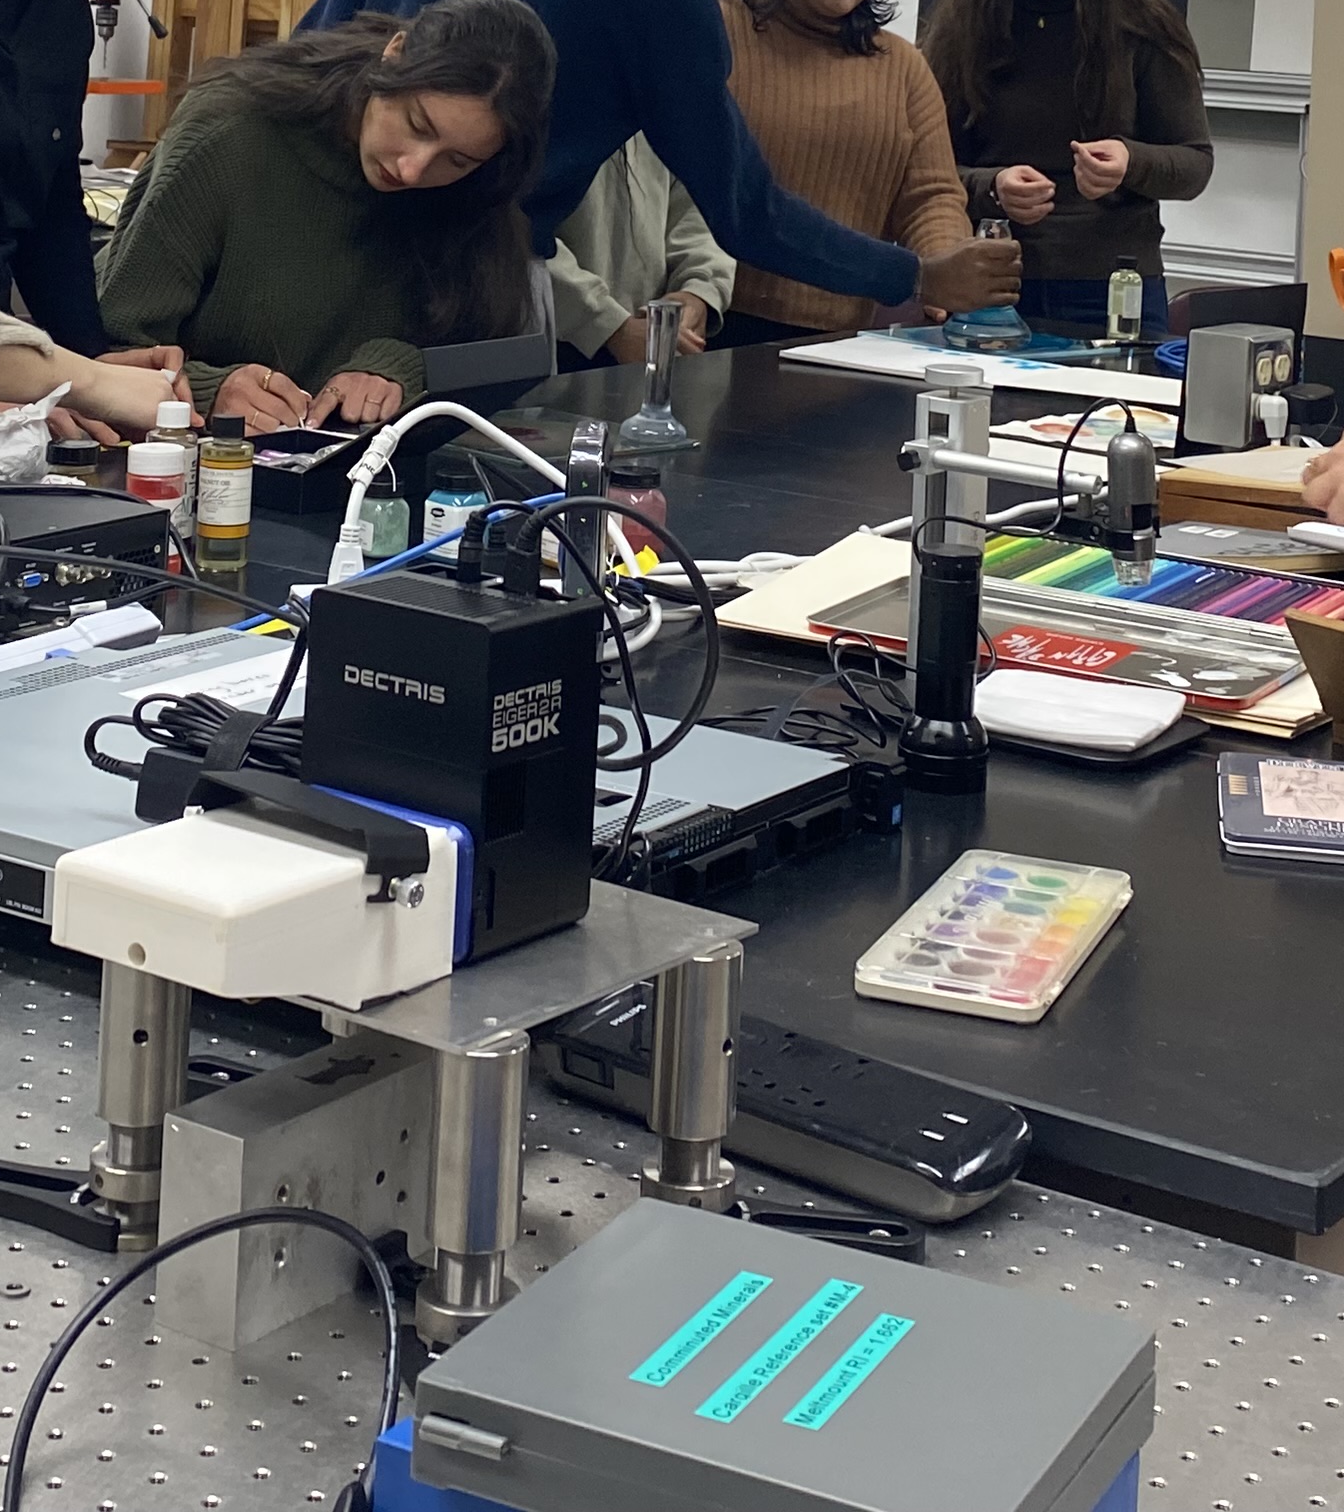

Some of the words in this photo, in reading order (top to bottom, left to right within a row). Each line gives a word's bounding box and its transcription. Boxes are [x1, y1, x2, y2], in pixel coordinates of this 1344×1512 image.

[344, 664, 445, 705] DECTRIS
[493, 679, 562, 710] DECTRIS
[491, 712, 560, 753] 500K
[646, 1317, 721, 1383] Comminuted
[712, 1279, 764, 1320] Minerals
[754, 1326, 815, 1378] Reference
[810, 1308, 832, 1332] set
[794, 1366, 856, 1425] Meltmount
